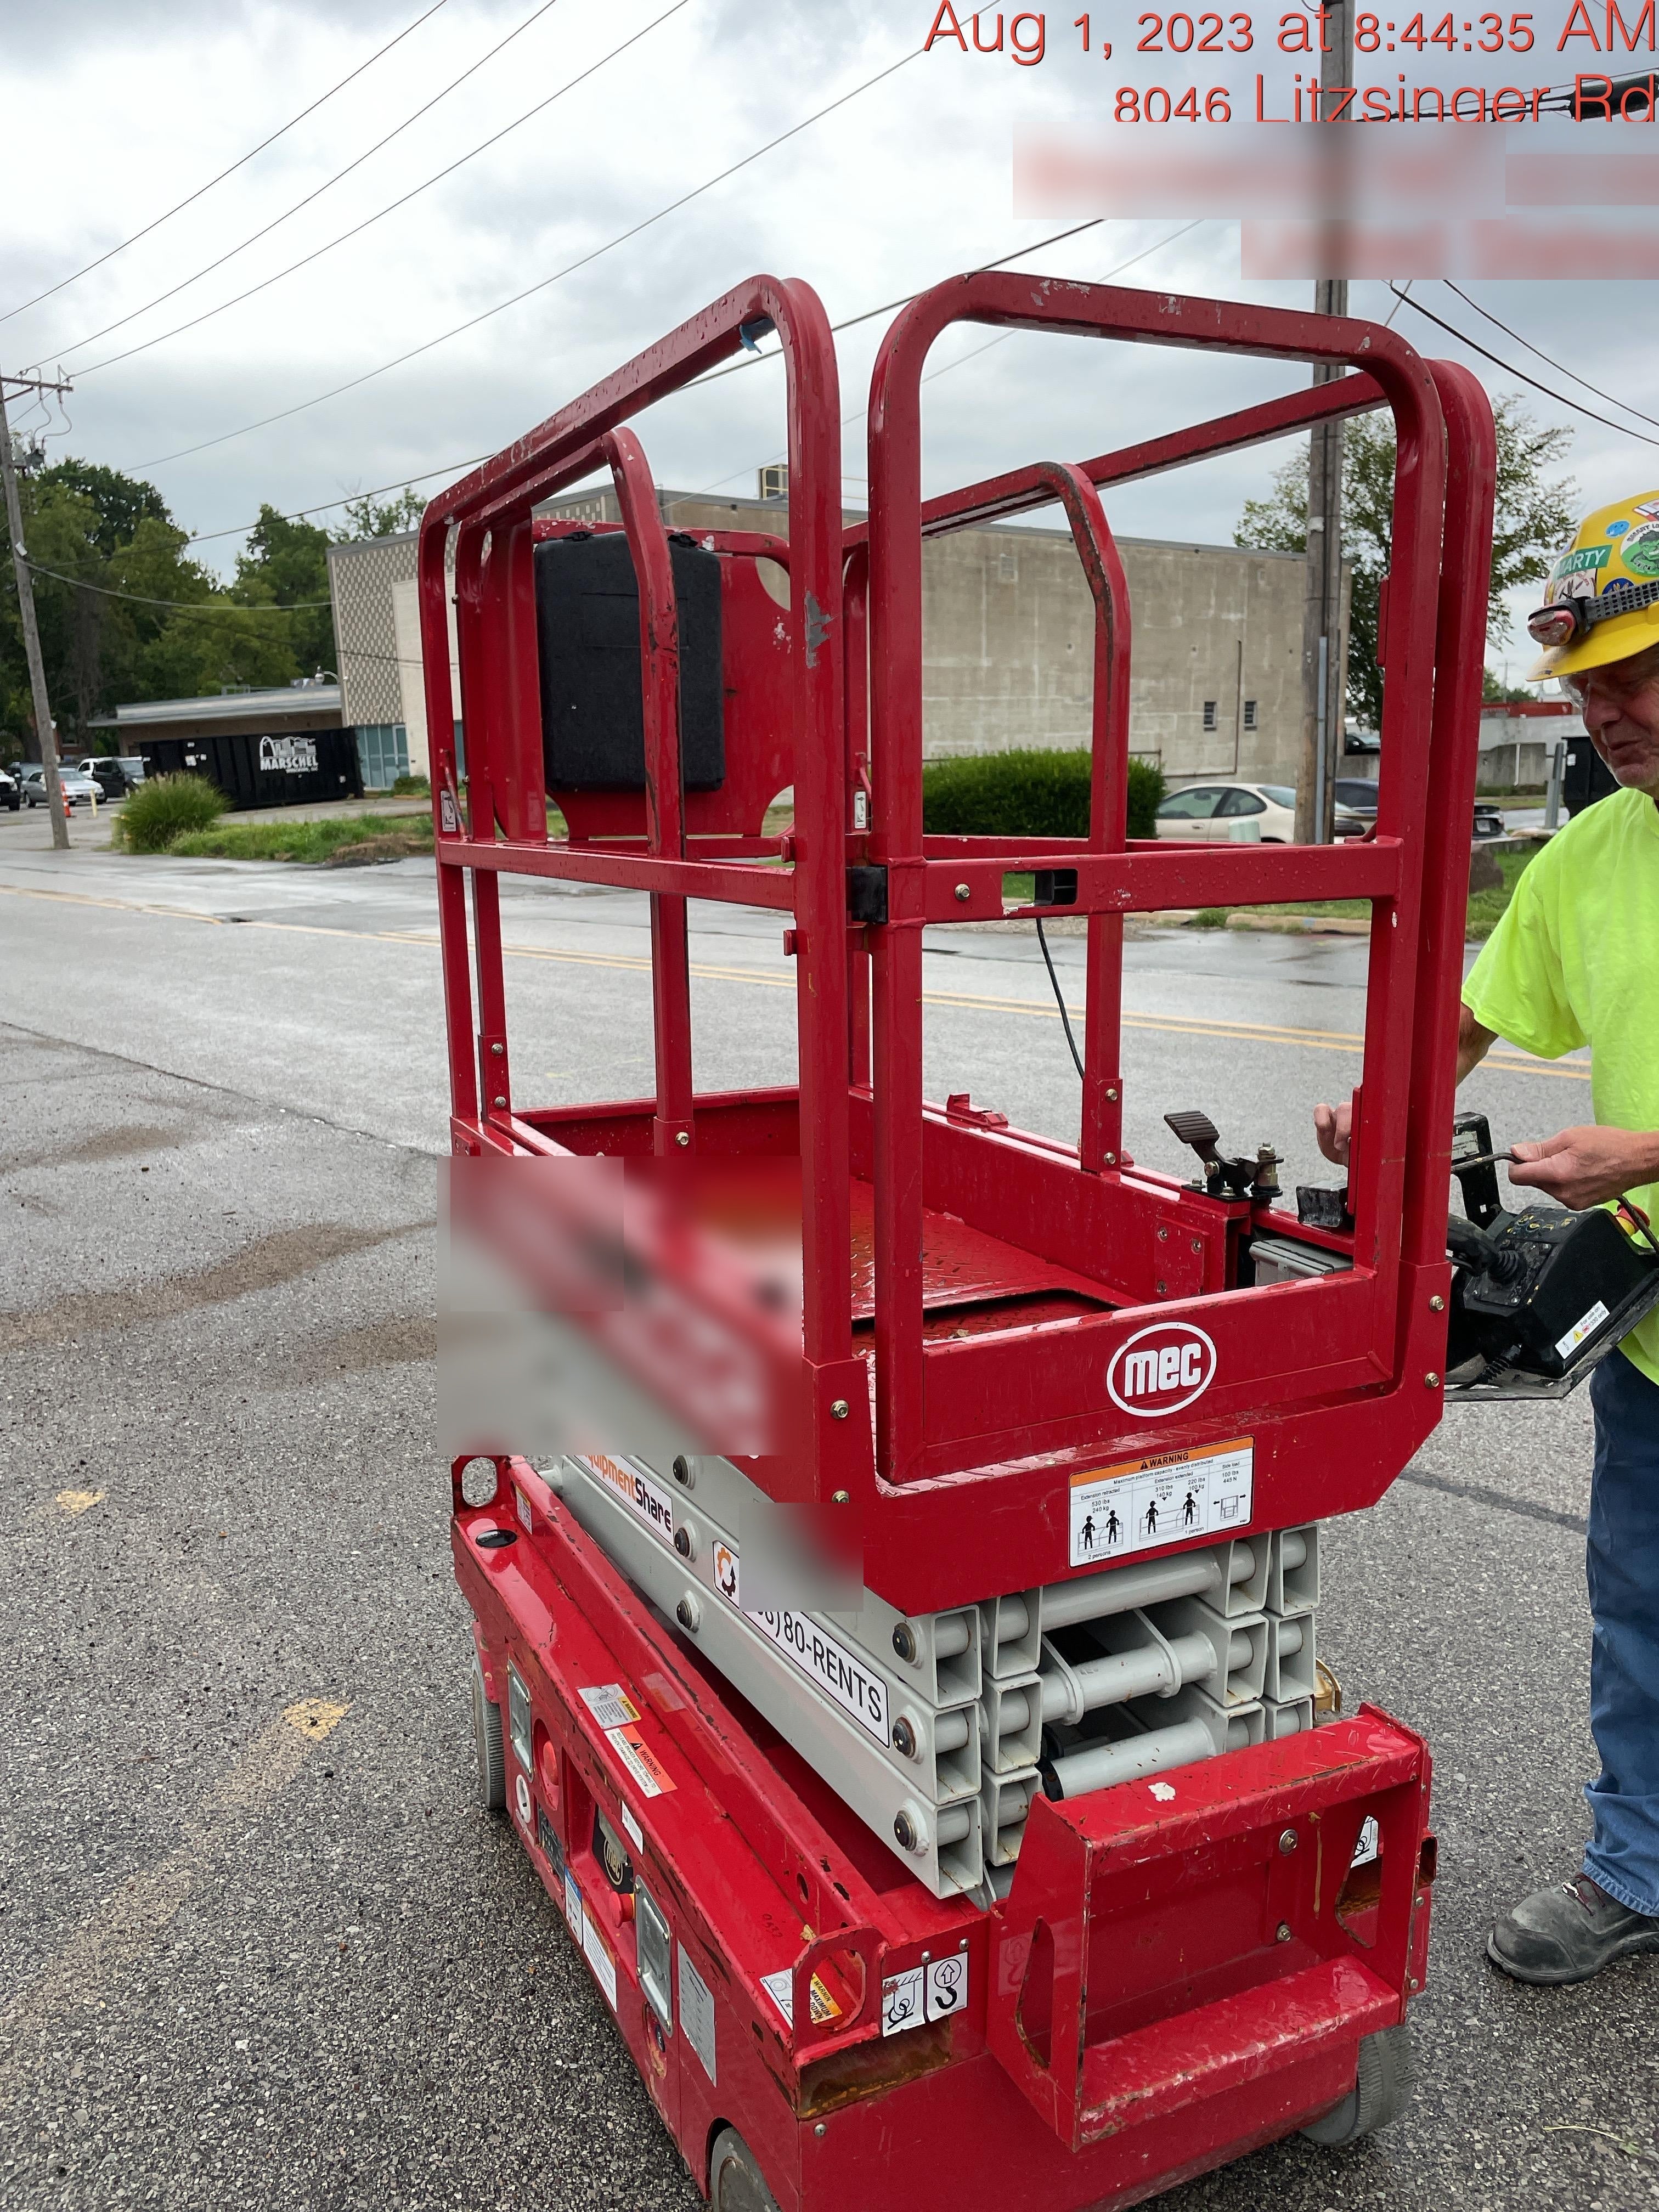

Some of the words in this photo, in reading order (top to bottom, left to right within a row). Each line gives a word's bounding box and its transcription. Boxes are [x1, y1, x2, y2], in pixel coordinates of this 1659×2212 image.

[260, 755, 319, 771] MARSCHEL
[1149, 1452, 1189, 1468] WARNING
[1114, 1476, 1135, 1485] Maximum
[1154, 1468, 1173, 1477] capacity
[1176, 1463, 1190, 1471] evenly
[1190, 1459, 1214, 1468] distributed
[1175, 1471, 1193, 1479] extended
[585, 1455, 671, 1533] quipmentShare
[1081, 1492, 1102, 1500] Extension
[1102, 1487, 1120, 1496] retracted
[1189, 1527, 1204, 1535] person
[1092, 1550, 1111, 1559] persons
[640, 1750, 661, 1776] WARNING
[814, 1980, 832, 2002] WARNIN
[811, 1990, 832, 2017] MAXIMUM
